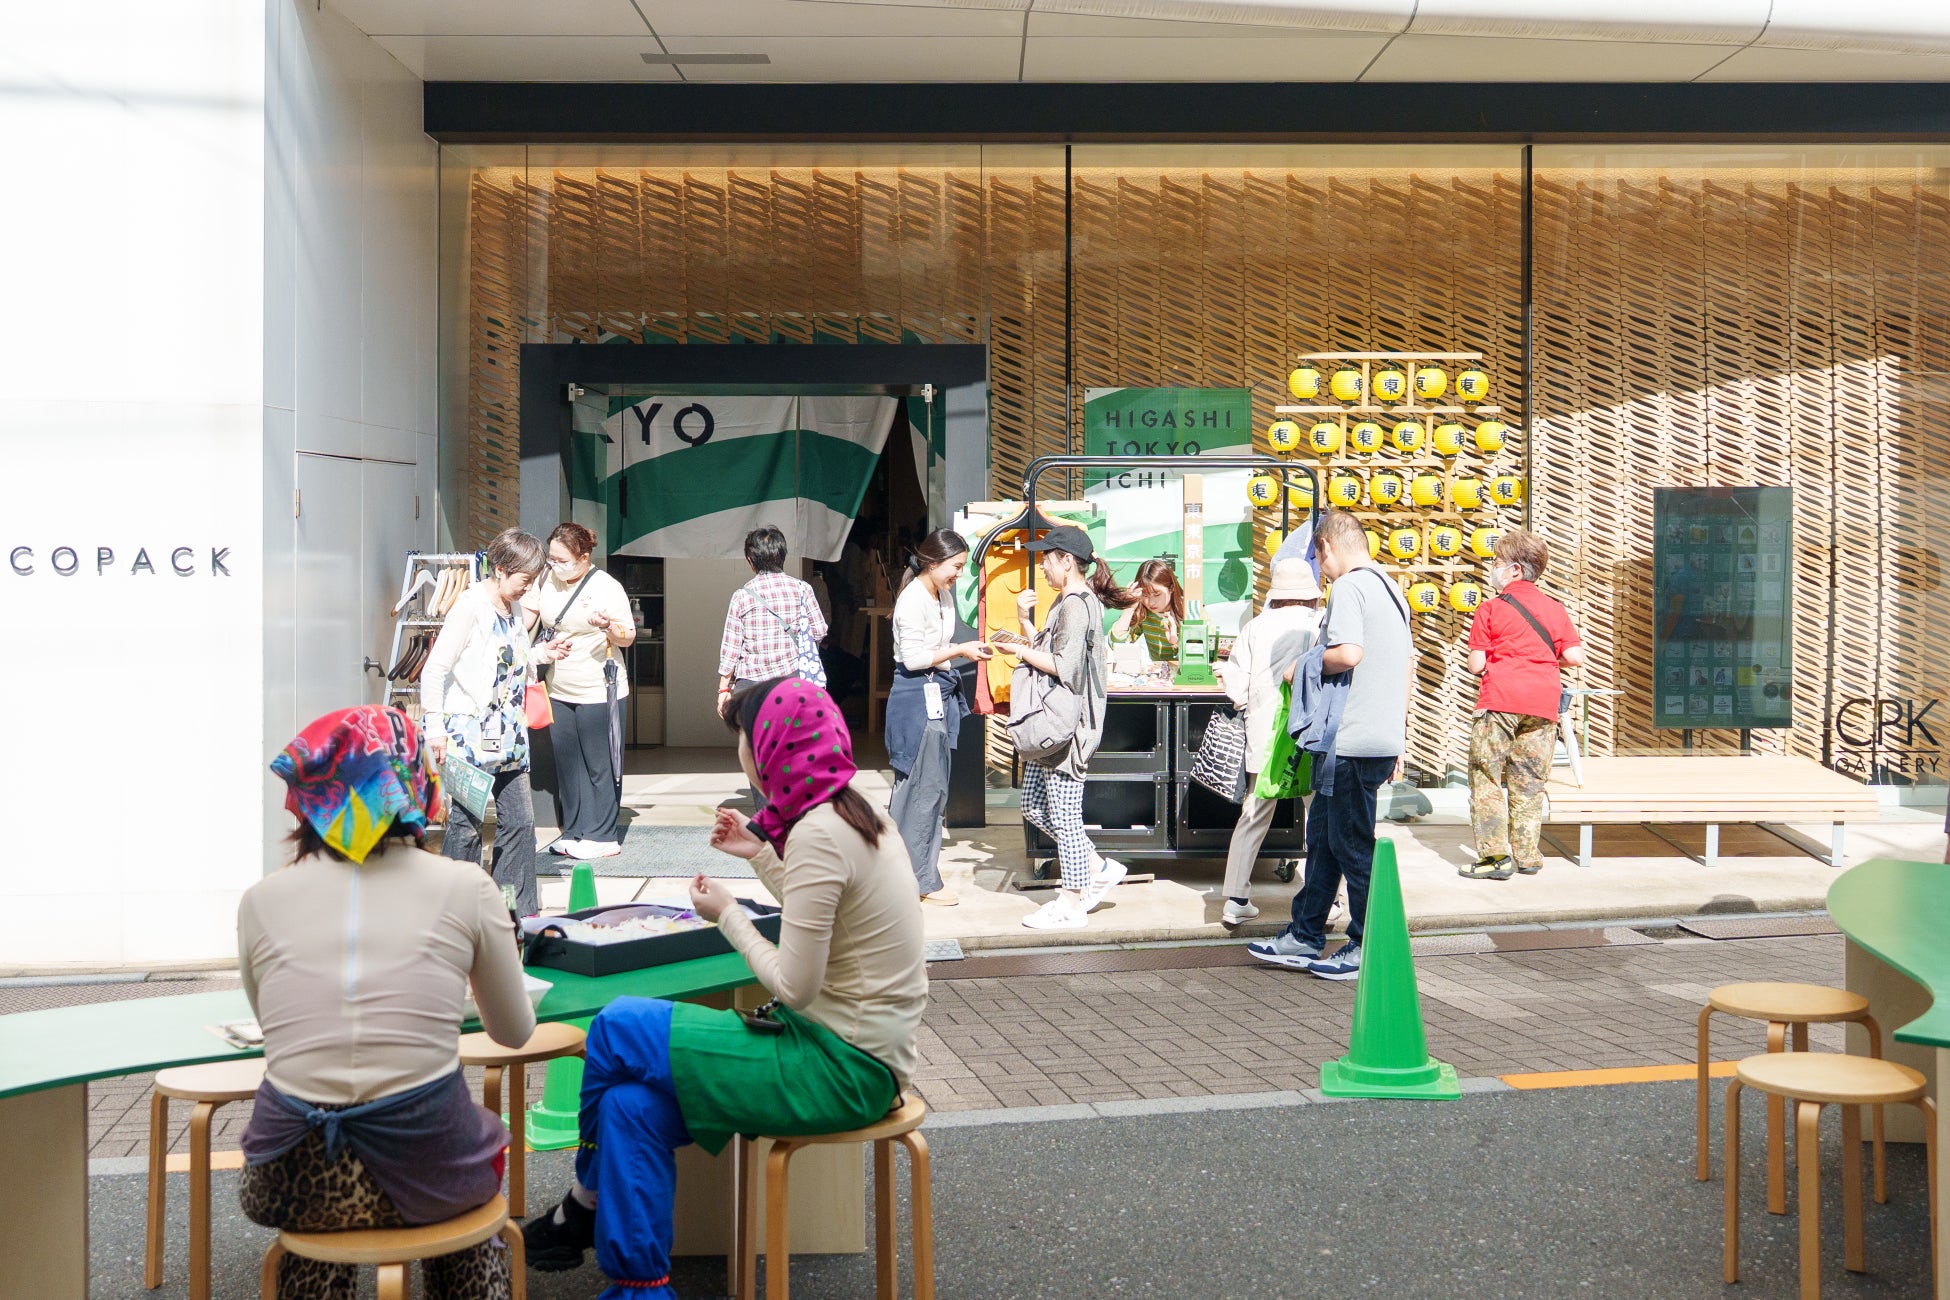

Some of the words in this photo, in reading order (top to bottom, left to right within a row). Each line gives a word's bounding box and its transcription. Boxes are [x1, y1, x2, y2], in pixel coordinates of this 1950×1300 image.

[1383, 377, 1399, 395] 東
[1460, 377, 1476, 394] 東
[1106, 410, 1231, 429] HIGASHI
[1273, 428, 1290, 446] 東
[1312, 430, 1328, 447] 東
[1356, 429, 1374, 446] 東
[1398, 428, 1415, 446] 東
[1106, 440, 1201, 456] TOKYO
[1106, 471, 1165, 489] ICHI
[1251, 482, 1268, 500] 東
[1342, 483, 1358, 500] 東
[1383, 481, 1398, 498] 東
[1496, 481, 1513, 499] 東
[1398, 535, 1415, 552] 東
[1436, 533, 1452, 551] 東
[10, 546, 231, 576] COPACK
[1419, 589, 1435, 607] 東
[1462, 589, 1478, 607] 東
[1836, 699, 1940, 746] CPK
[1835, 758, 1941, 773] GALLERY
